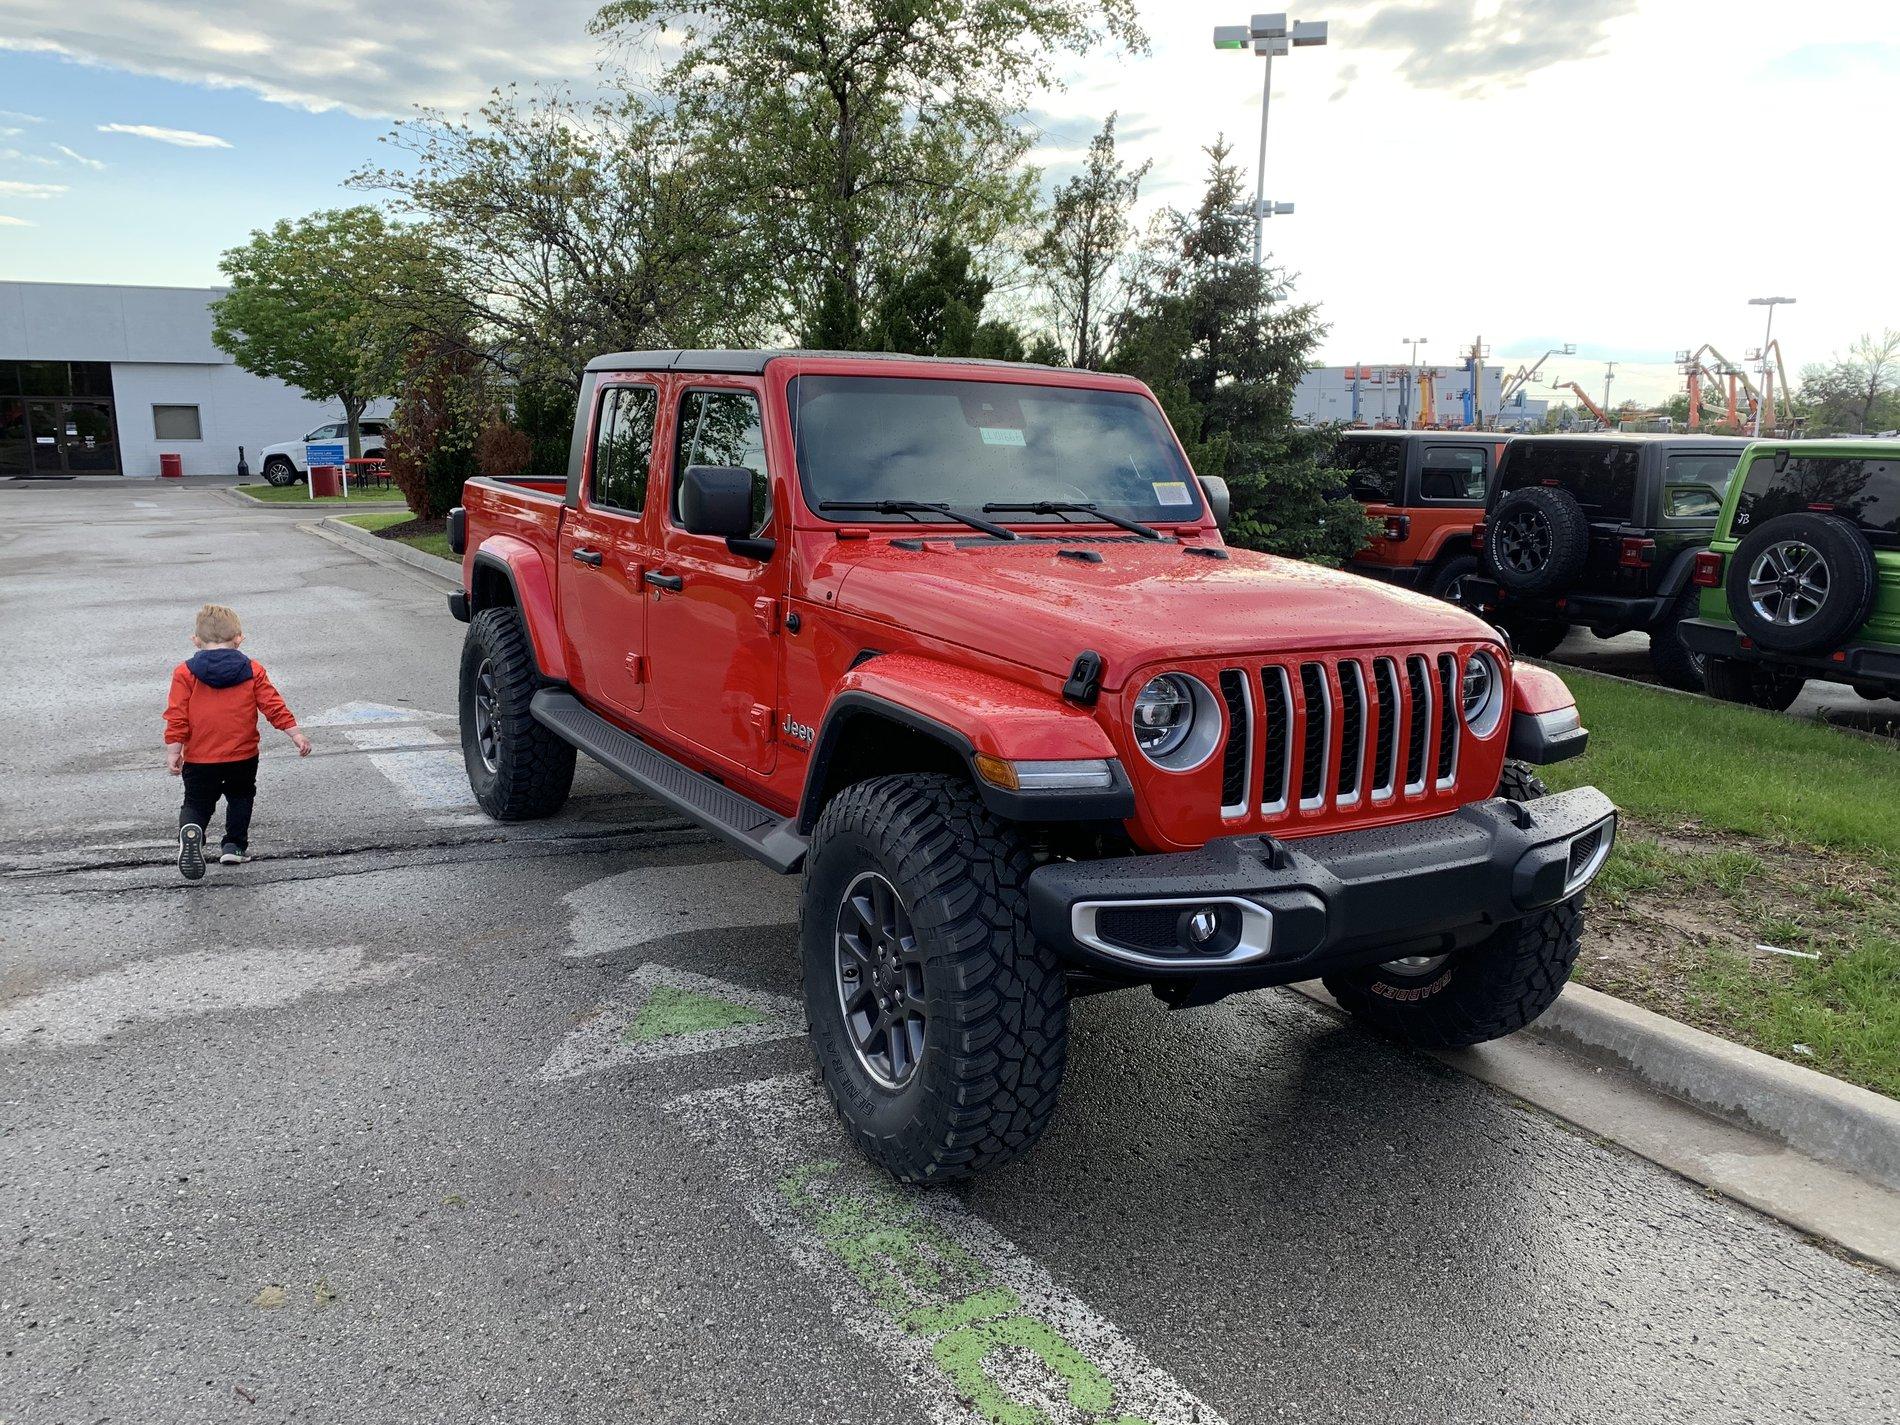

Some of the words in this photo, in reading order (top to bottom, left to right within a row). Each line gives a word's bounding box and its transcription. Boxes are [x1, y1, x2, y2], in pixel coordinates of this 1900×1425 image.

[782, 713, 815, 746] Jeep
[1371, 969, 1452, 1001] GRABBER
[822, 1022, 876, 1117] GENERAL
[778, 1159, 1151, 1425] GEIC
